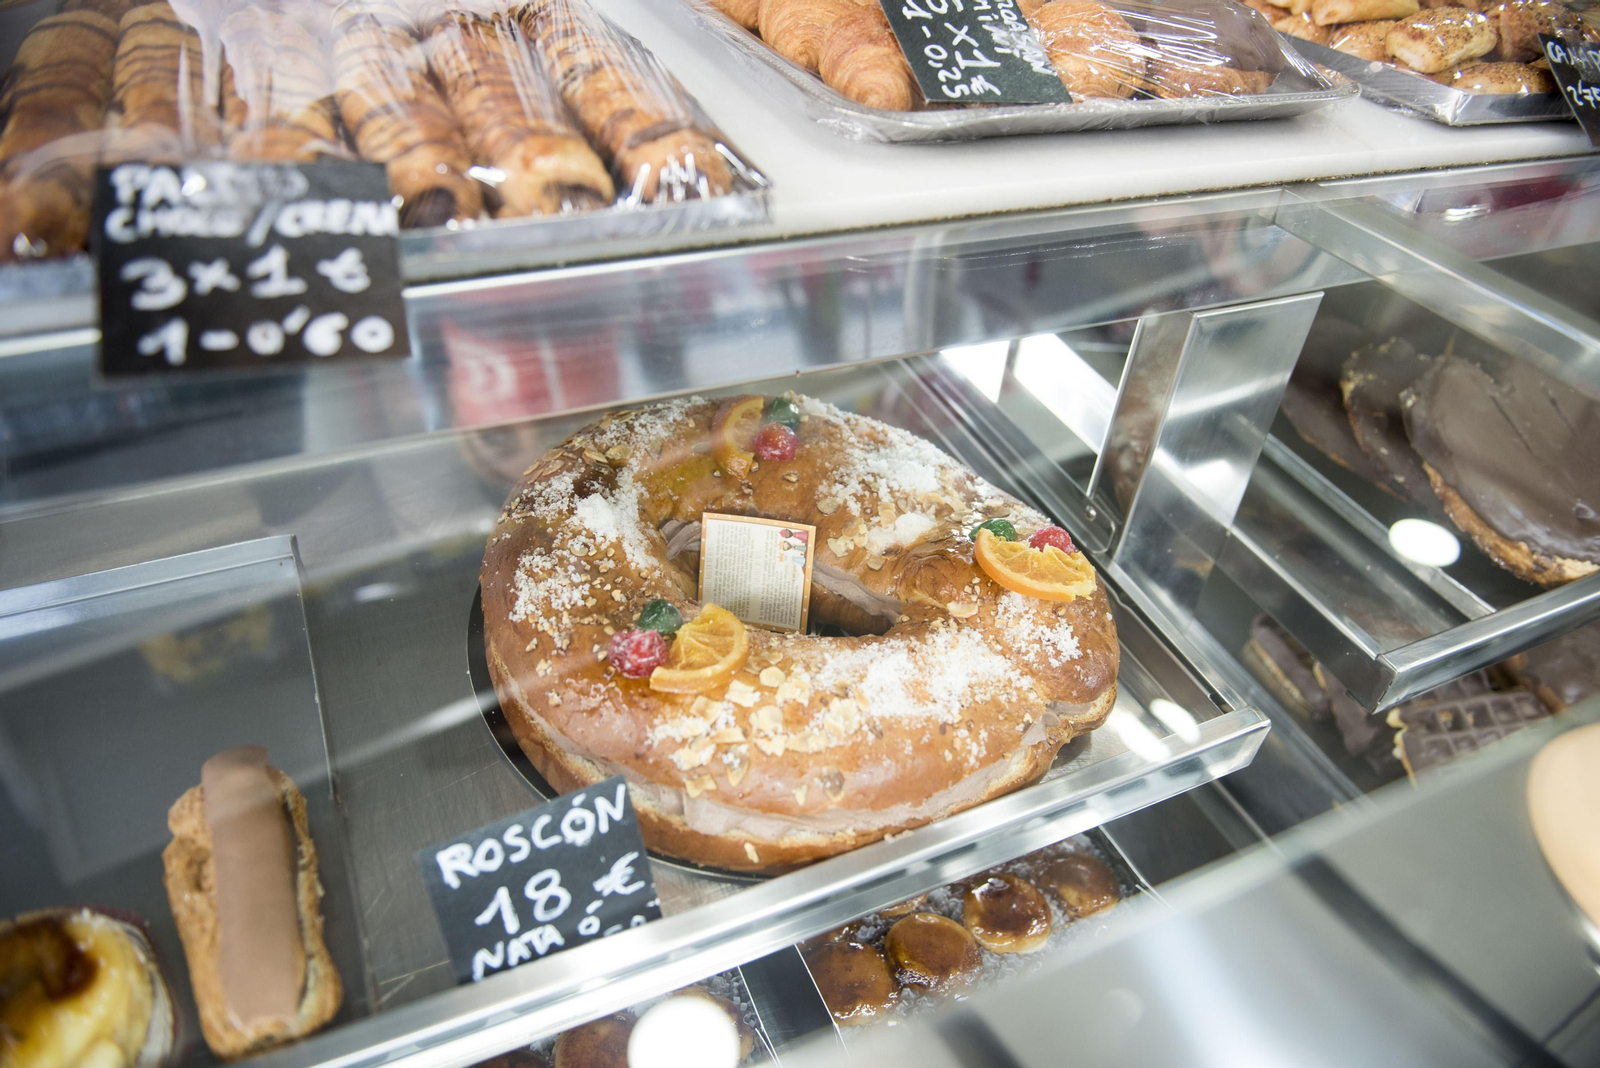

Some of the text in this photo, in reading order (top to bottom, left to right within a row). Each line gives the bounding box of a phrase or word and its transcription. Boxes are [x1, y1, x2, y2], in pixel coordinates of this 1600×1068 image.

[435, 783, 626, 889] ROSCÓN
[474, 868, 573, 935] 18
[472, 924, 565, 982] NATA
